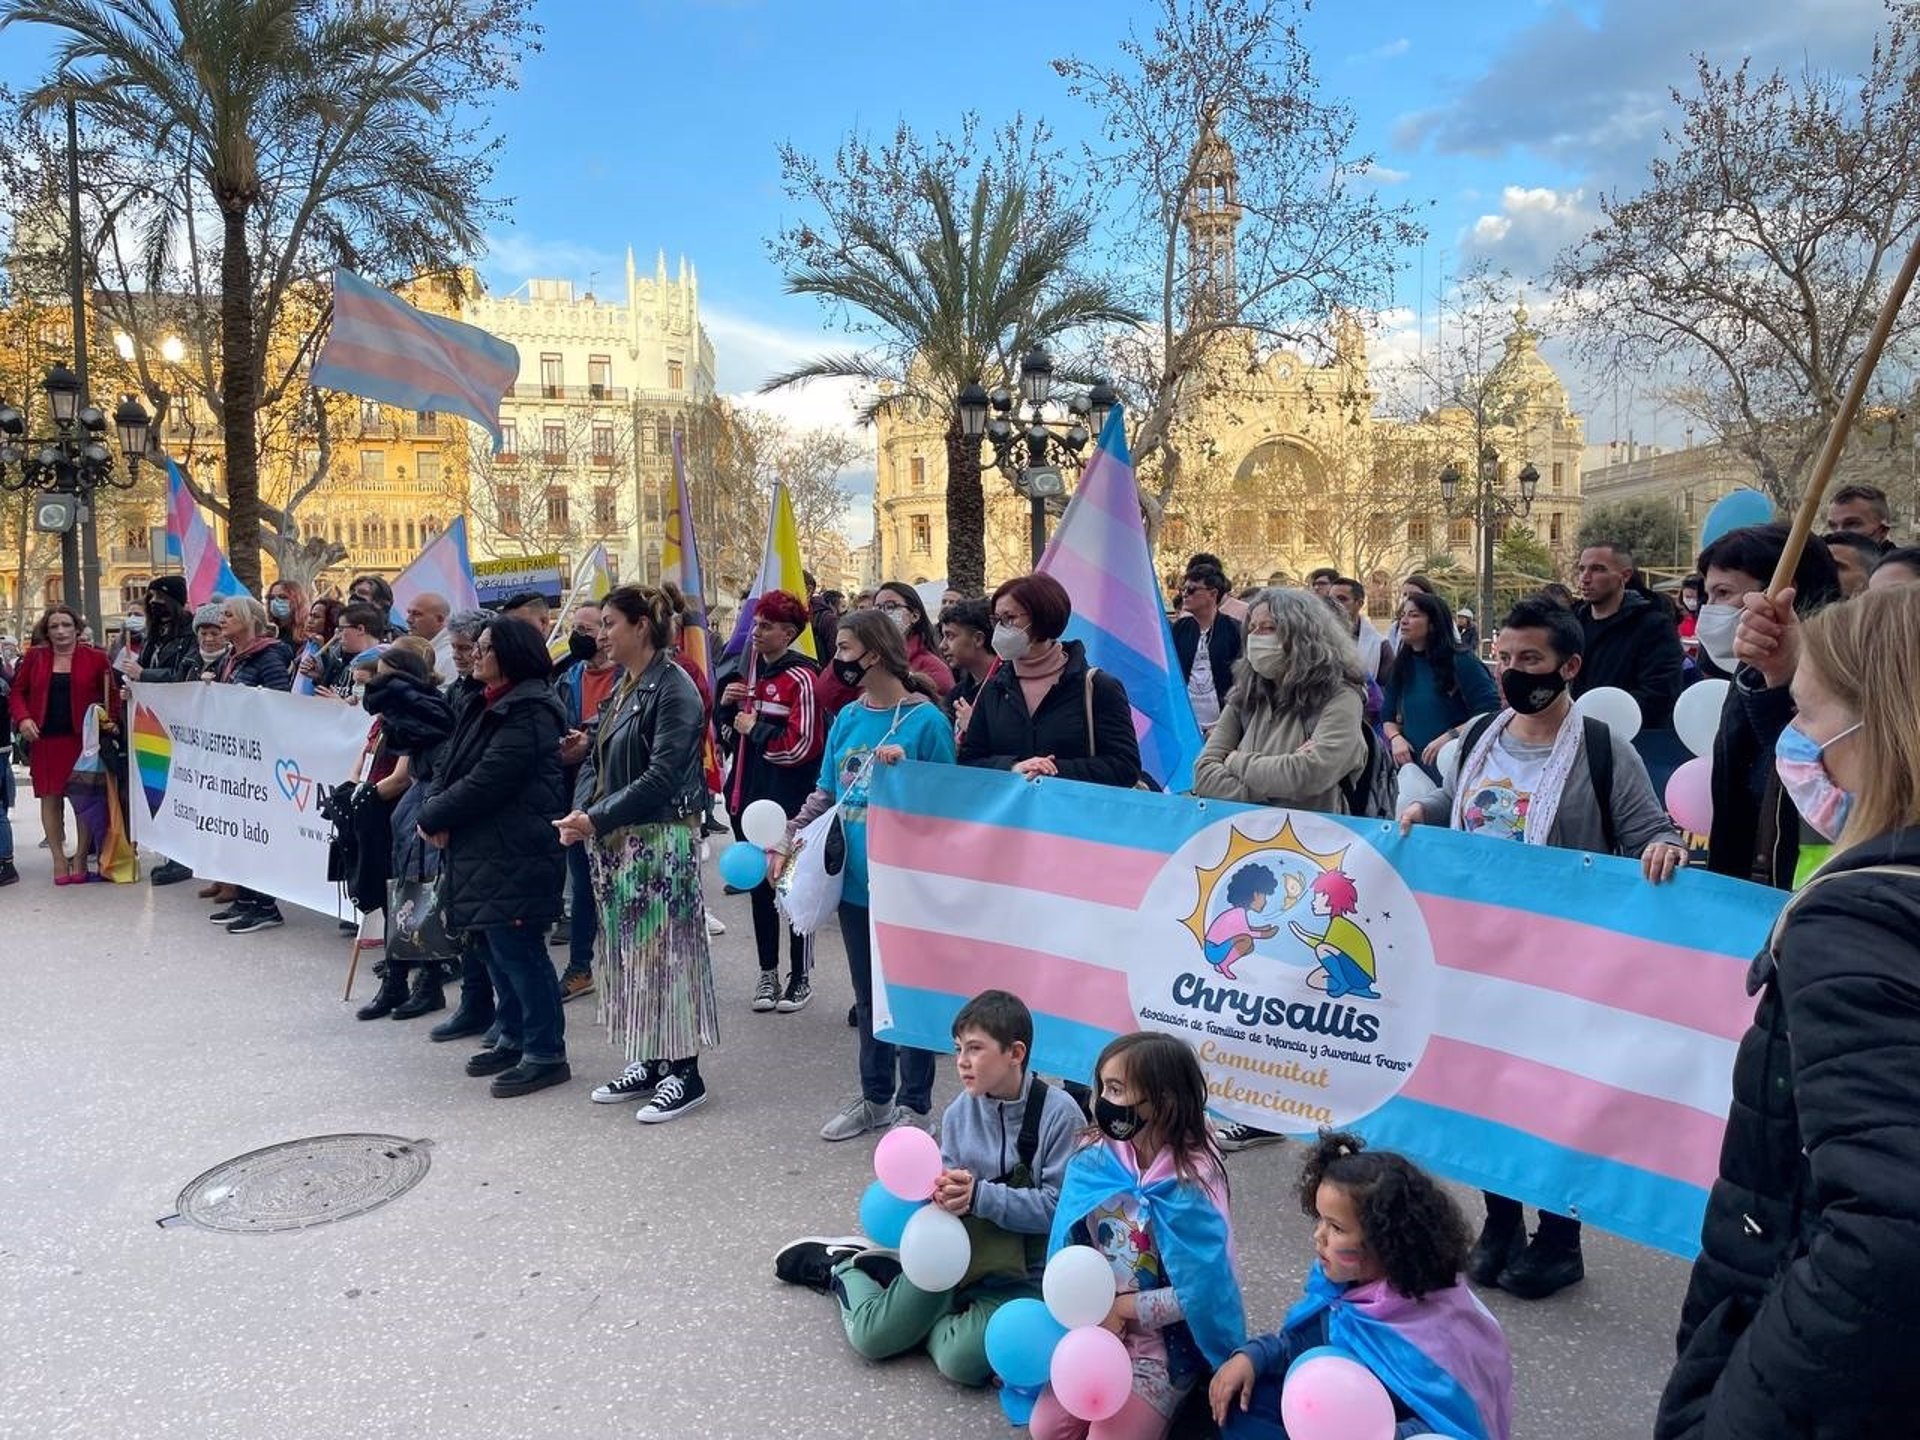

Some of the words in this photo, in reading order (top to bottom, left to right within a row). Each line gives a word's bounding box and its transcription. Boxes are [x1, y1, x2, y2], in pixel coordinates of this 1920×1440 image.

[220, 777, 268, 802] madres
[243, 818, 269, 845] lado
[1172, 972, 1380, 1043] Chrysallis
[1140, 1007, 1189, 1028] Asociación
[1191, 1019, 1202, 1031] de
[1205, 1020, 1246, 1040] Familias
[1249, 1032, 1262, 1043] de
[1265, 1033, 1308, 1053] Infancia
[1310, 1044, 1318, 1060] y
[1320, 1045, 1372, 1065] Juventud
[1200, 1040, 1329, 1089] Comunitat
